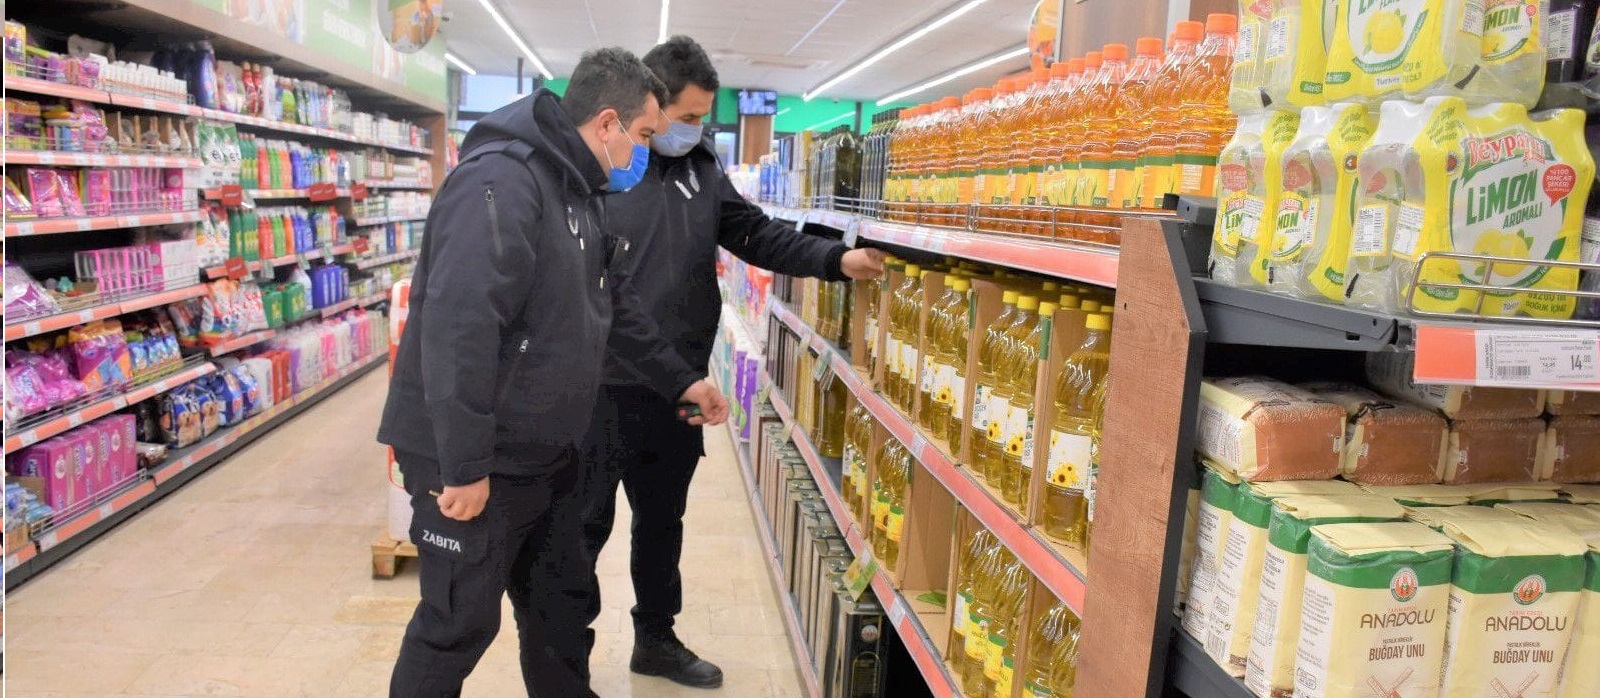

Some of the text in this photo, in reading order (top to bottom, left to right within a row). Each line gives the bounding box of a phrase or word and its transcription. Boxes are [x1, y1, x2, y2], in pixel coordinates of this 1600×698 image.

[1502, 202, 1543, 229] AROMALI
[1571, 354, 1582, 371] 14
[422, 529, 461, 552] ZABITA
[1360, 608, 1436, 629] ANADOLU
[1485, 616, 1568, 632] ANADOLU
[1369, 643, 1425, 661] BUĞDAY UNU
[1493, 649, 1554, 664] BUĞDAY UNU
